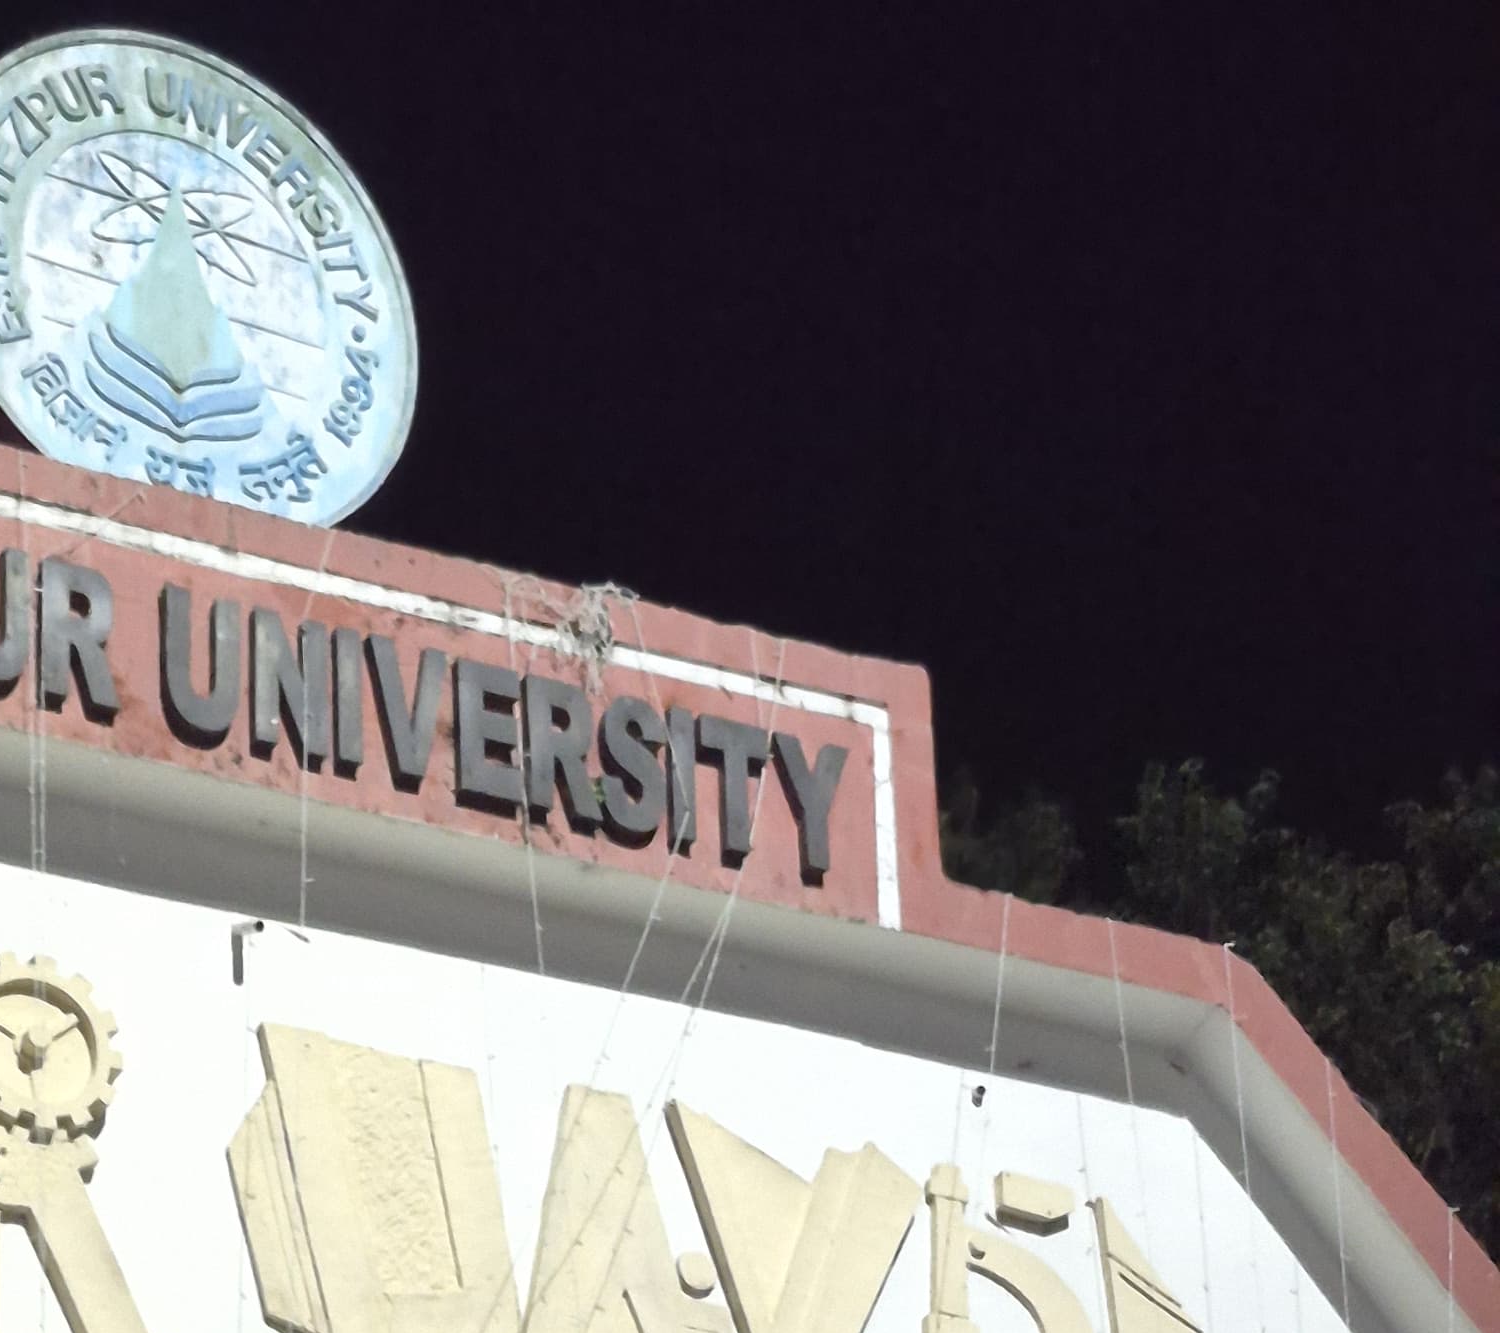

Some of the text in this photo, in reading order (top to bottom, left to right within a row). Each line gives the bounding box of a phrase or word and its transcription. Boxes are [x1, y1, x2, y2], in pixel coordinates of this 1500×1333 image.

[144, 66, 379, 323] UNIVERSITY
[323, 345, 380, 448] 1994
[158, 581, 848, 887] UNIVERSITY
